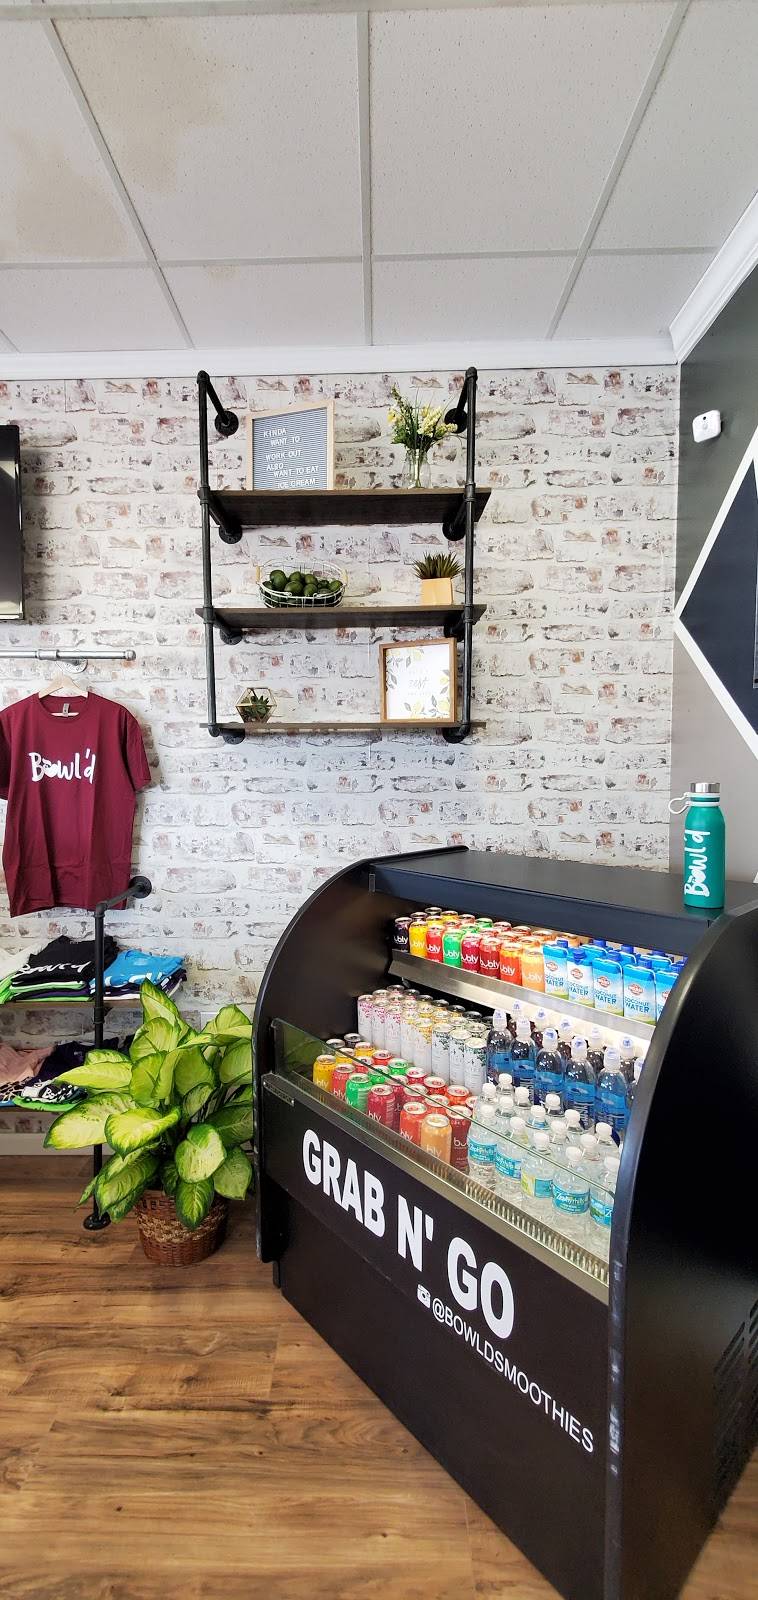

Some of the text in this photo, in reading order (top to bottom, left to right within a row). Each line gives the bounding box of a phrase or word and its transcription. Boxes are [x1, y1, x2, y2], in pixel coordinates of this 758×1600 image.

[263, 428, 287, 438] KINDA
[270, 437, 288, 447] WANT
[265, 450, 301, 462] WORK OUT
[266, 463, 283, 471] ALSO
[273, 465, 318, 478] WANT TO EAT
[277, 478, 315, 489] ICE CREAM
[28, 748, 96, 785] Bowl'd
[683, 829, 711, 898] Bowl'd
[302, 1129, 515, 1339] GRAB N' GO
[432, 1297, 594, 1453] @BOWLDSMOOTHIES
